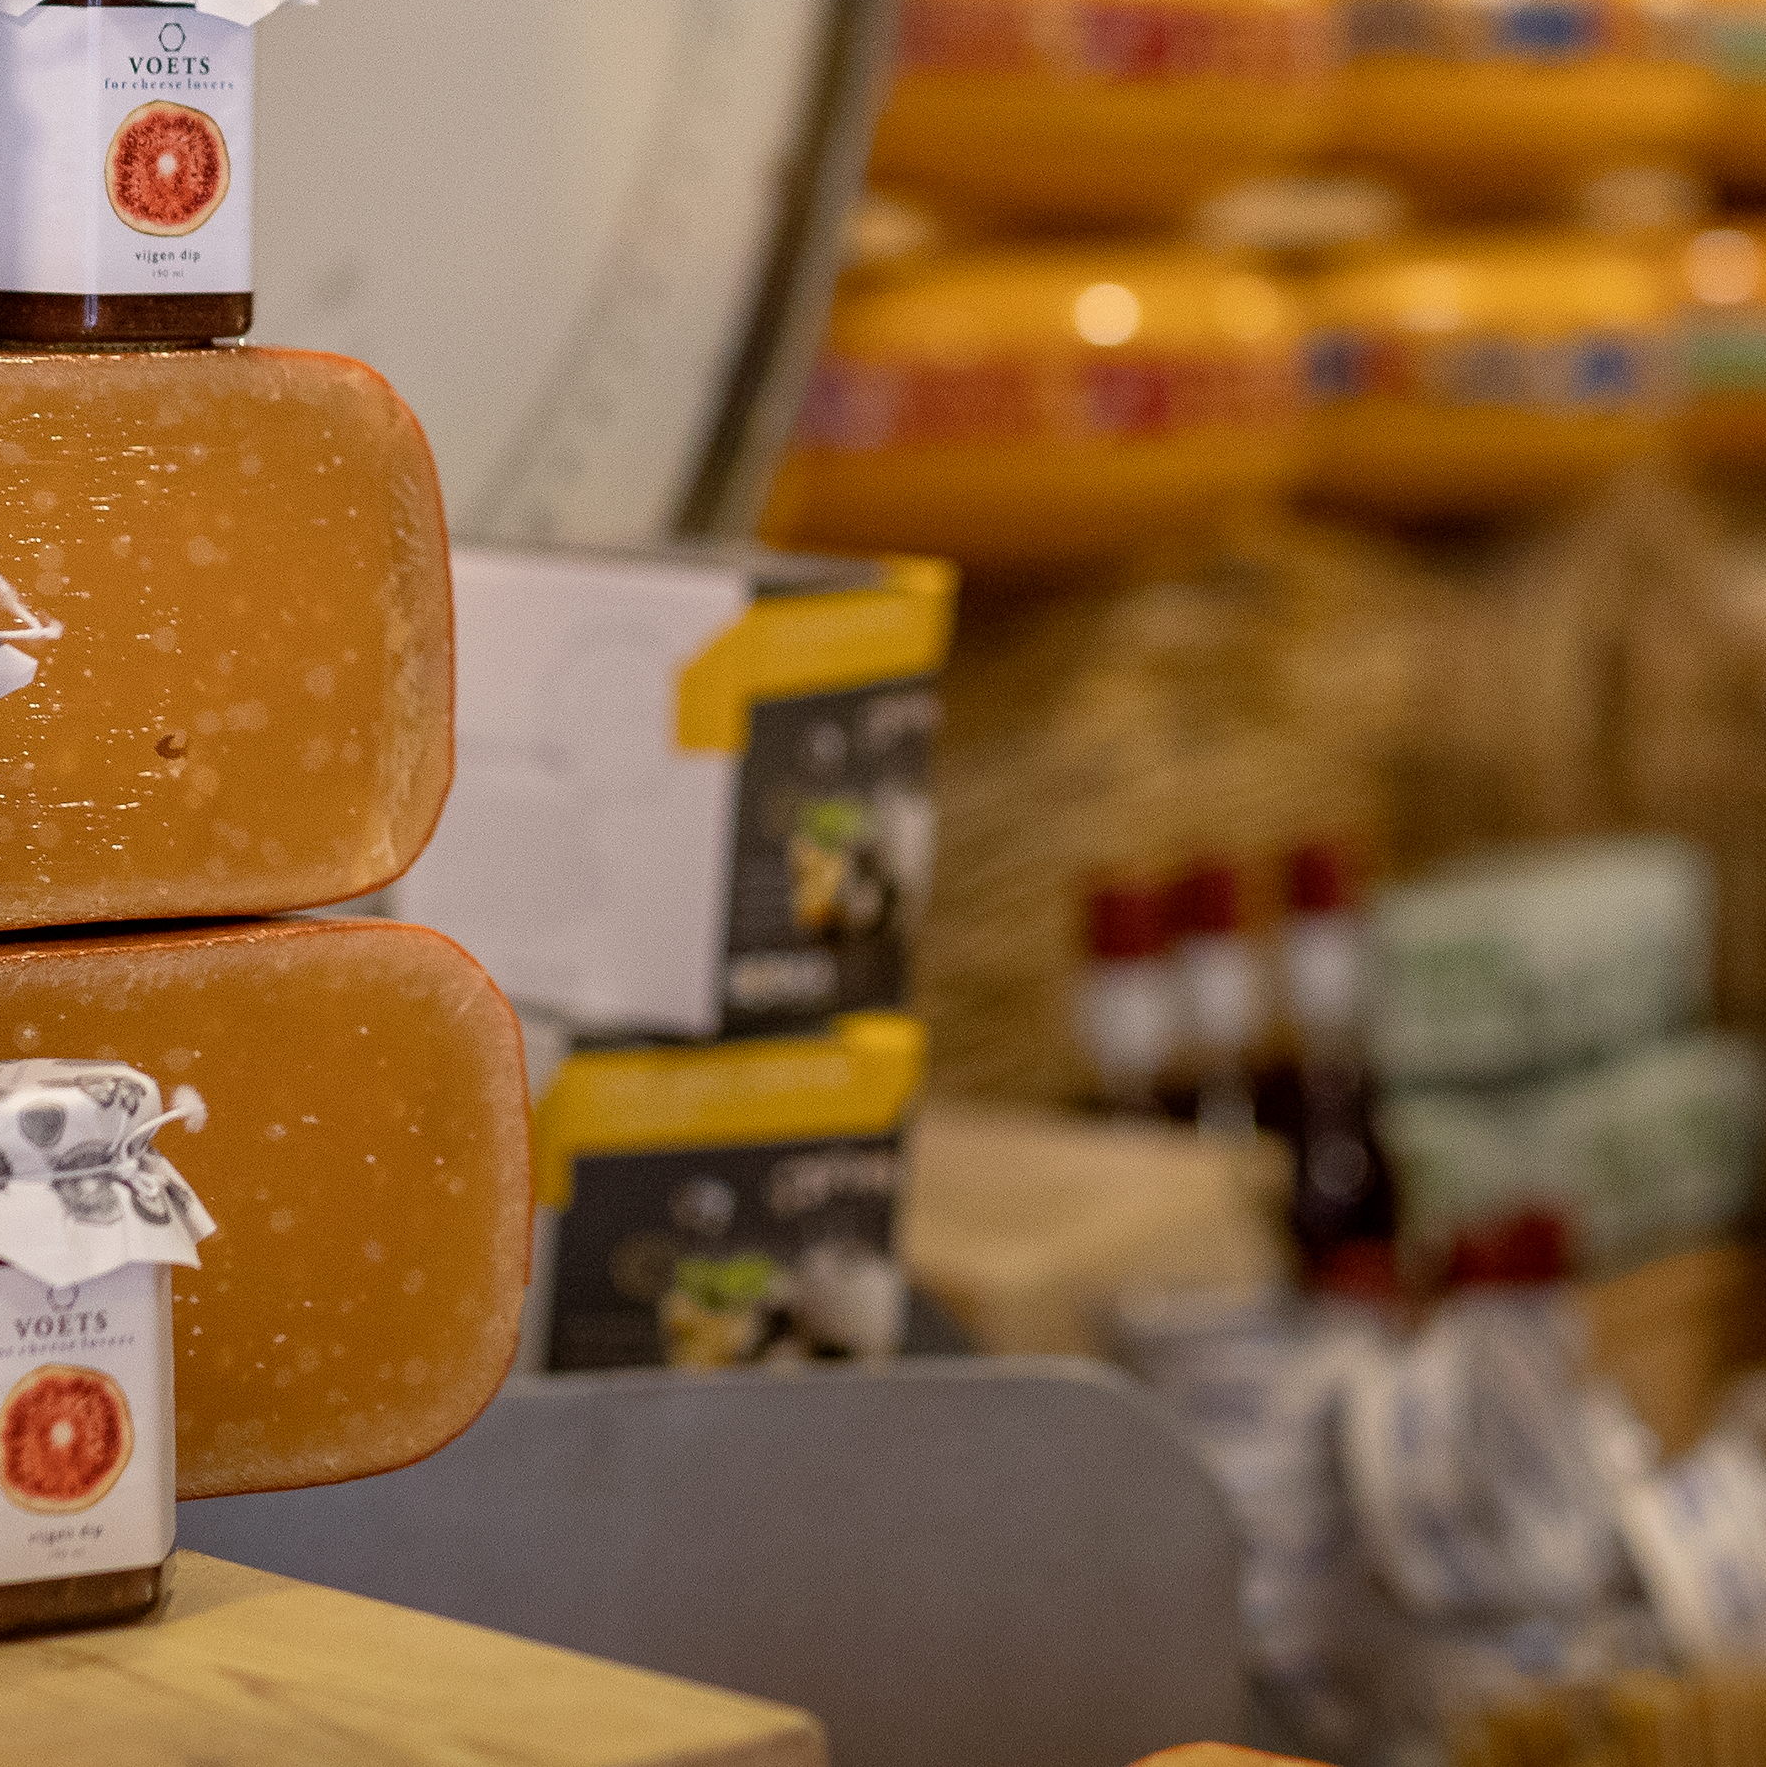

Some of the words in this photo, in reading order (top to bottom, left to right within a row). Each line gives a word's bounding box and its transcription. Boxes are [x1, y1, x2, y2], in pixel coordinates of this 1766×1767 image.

[129, 56, 211, 75] VOETS
[104, 77, 126, 90] for
[131, 78, 182, 90] cheese
[134, 250, 175, 264] vijgen
[179, 248, 201, 263] dip
